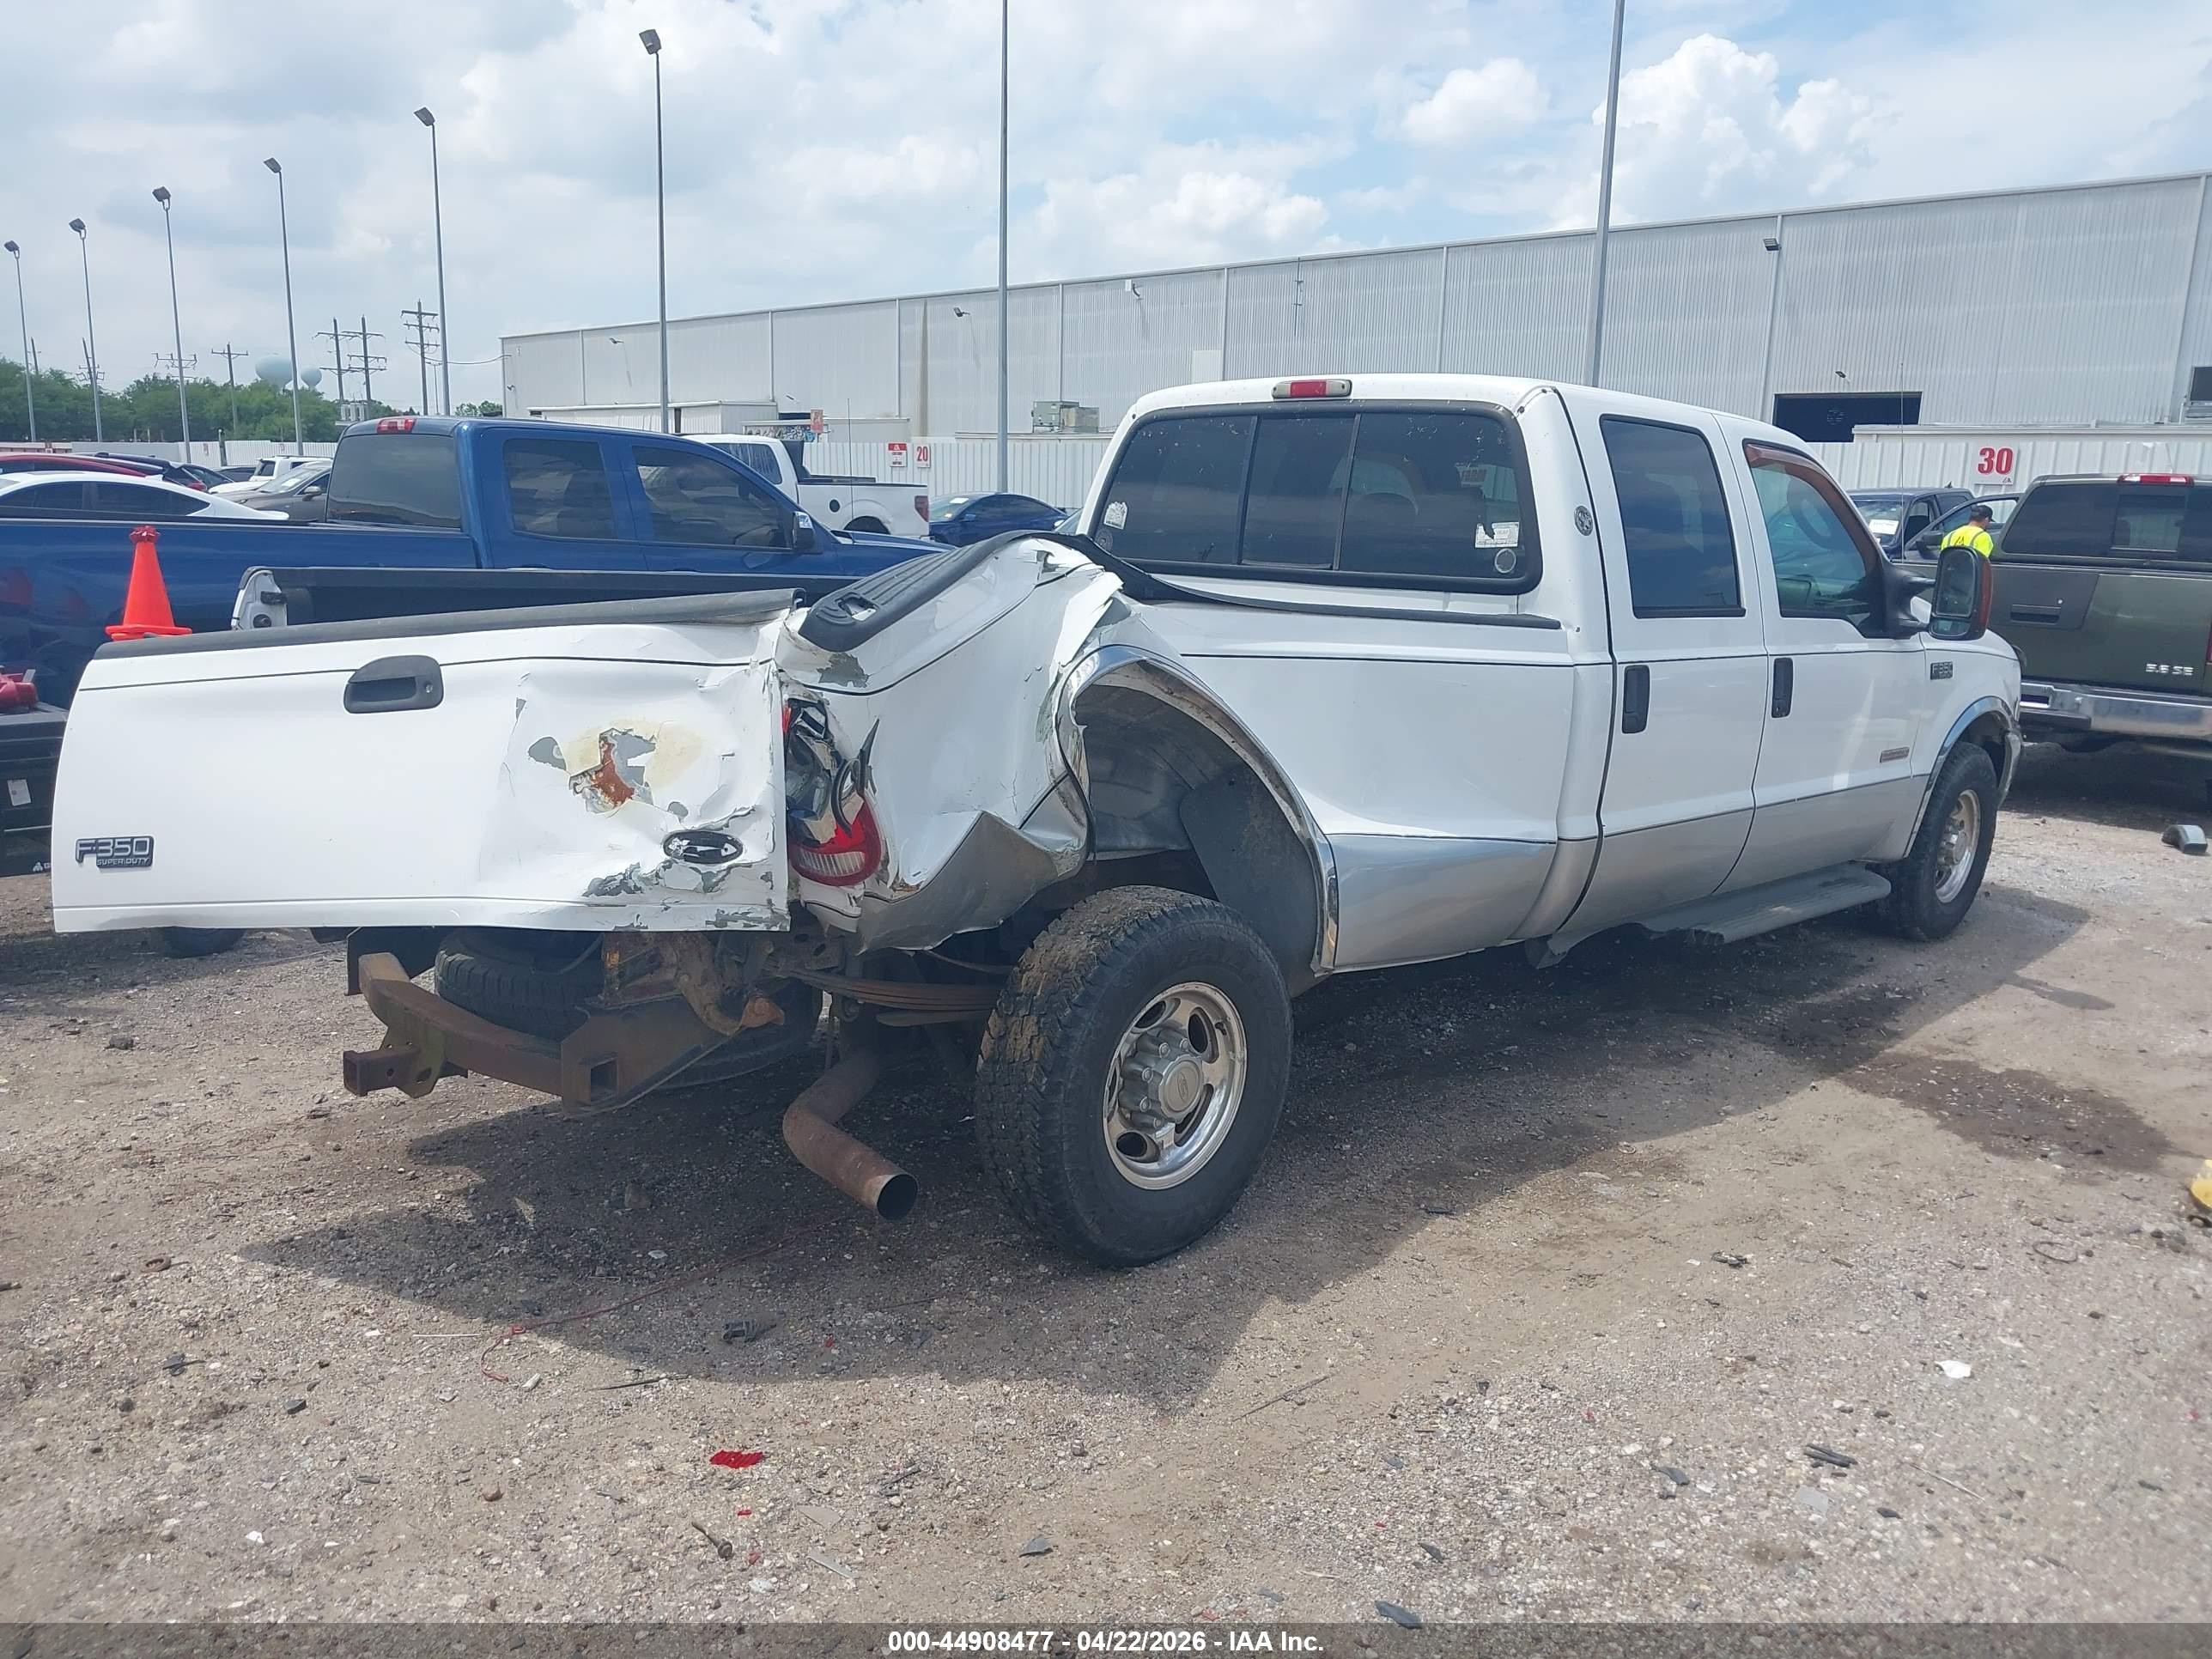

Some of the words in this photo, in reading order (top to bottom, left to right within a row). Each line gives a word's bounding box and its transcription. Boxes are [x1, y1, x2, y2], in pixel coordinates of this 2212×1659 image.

[916, 446, 929, 462] 20
[1978, 447, 2014, 474] 30
[2172, 665, 2194, 676] SE
